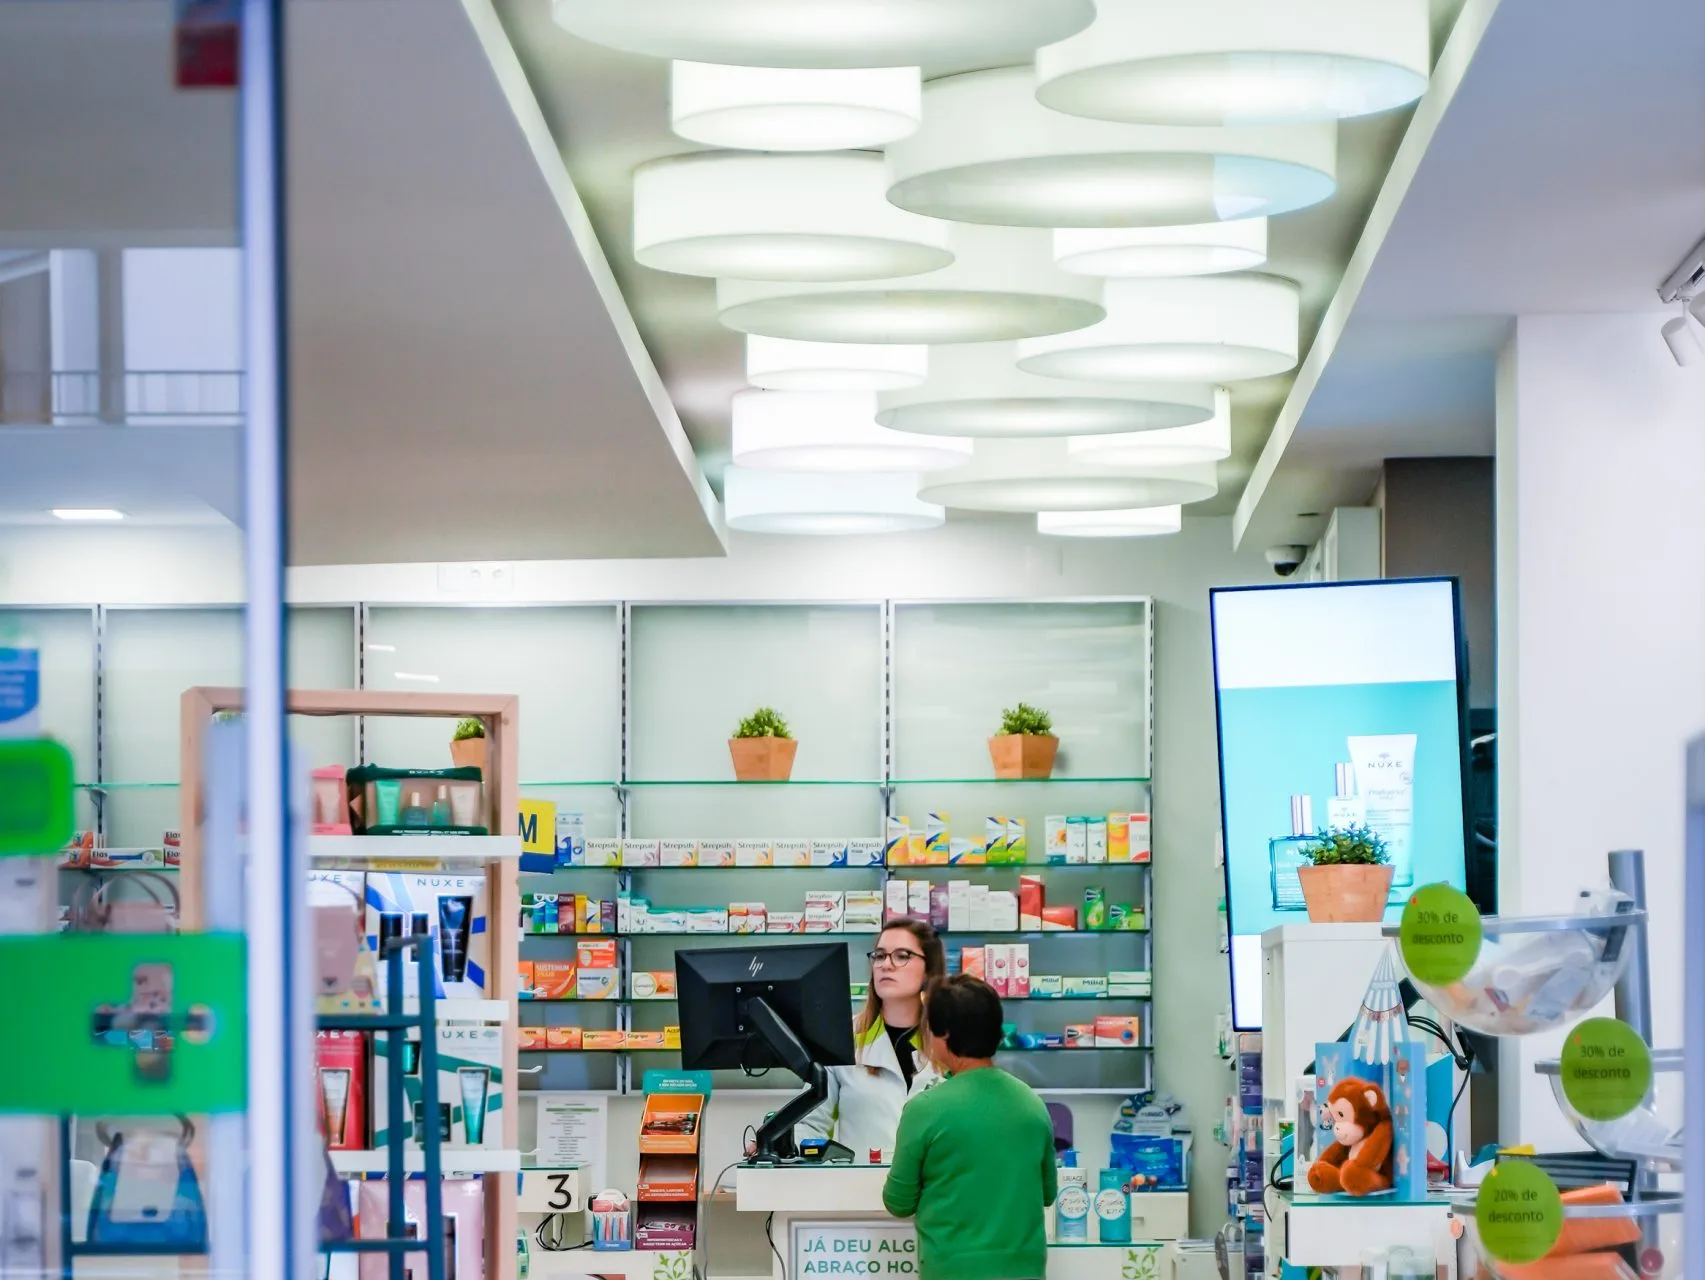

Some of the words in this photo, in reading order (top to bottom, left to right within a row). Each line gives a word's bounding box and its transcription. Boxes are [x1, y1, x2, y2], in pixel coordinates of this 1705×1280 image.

[1367, 760, 1403, 769] NUXE
[587, 842, 618, 850] Strepsils
[663, 842, 694, 850] Strepsils
[701, 842, 732, 850] Strepsils
[738, 842, 769, 850] Strepsils
[813, 841, 844, 849] Strepsils
[416, 878, 465, 888] NUXE
[1418, 911, 1440, 924] 30%
[1443, 910, 1459, 924] de
[1412, 932, 1465, 945] desconto
[442, 1030, 478, 1039] UXE
[1580, 1045, 1605, 1058] 30%
[1608, 1044, 1626, 1058] de
[1573, 1066, 1631, 1080] desconto
[547, 1174, 572, 1209] 3
[1494, 1189, 1519, 1203] 20%
[1522, 1188, 1538, 1202] de
[1488, 1210, 1545, 1223] desconto
[803, 1236, 826, 1253] JÁ
[833, 1239, 872, 1253] DEU
[878, 1239, 918, 1253] ALG
[804, 1260, 881, 1276] ABRAÇO
